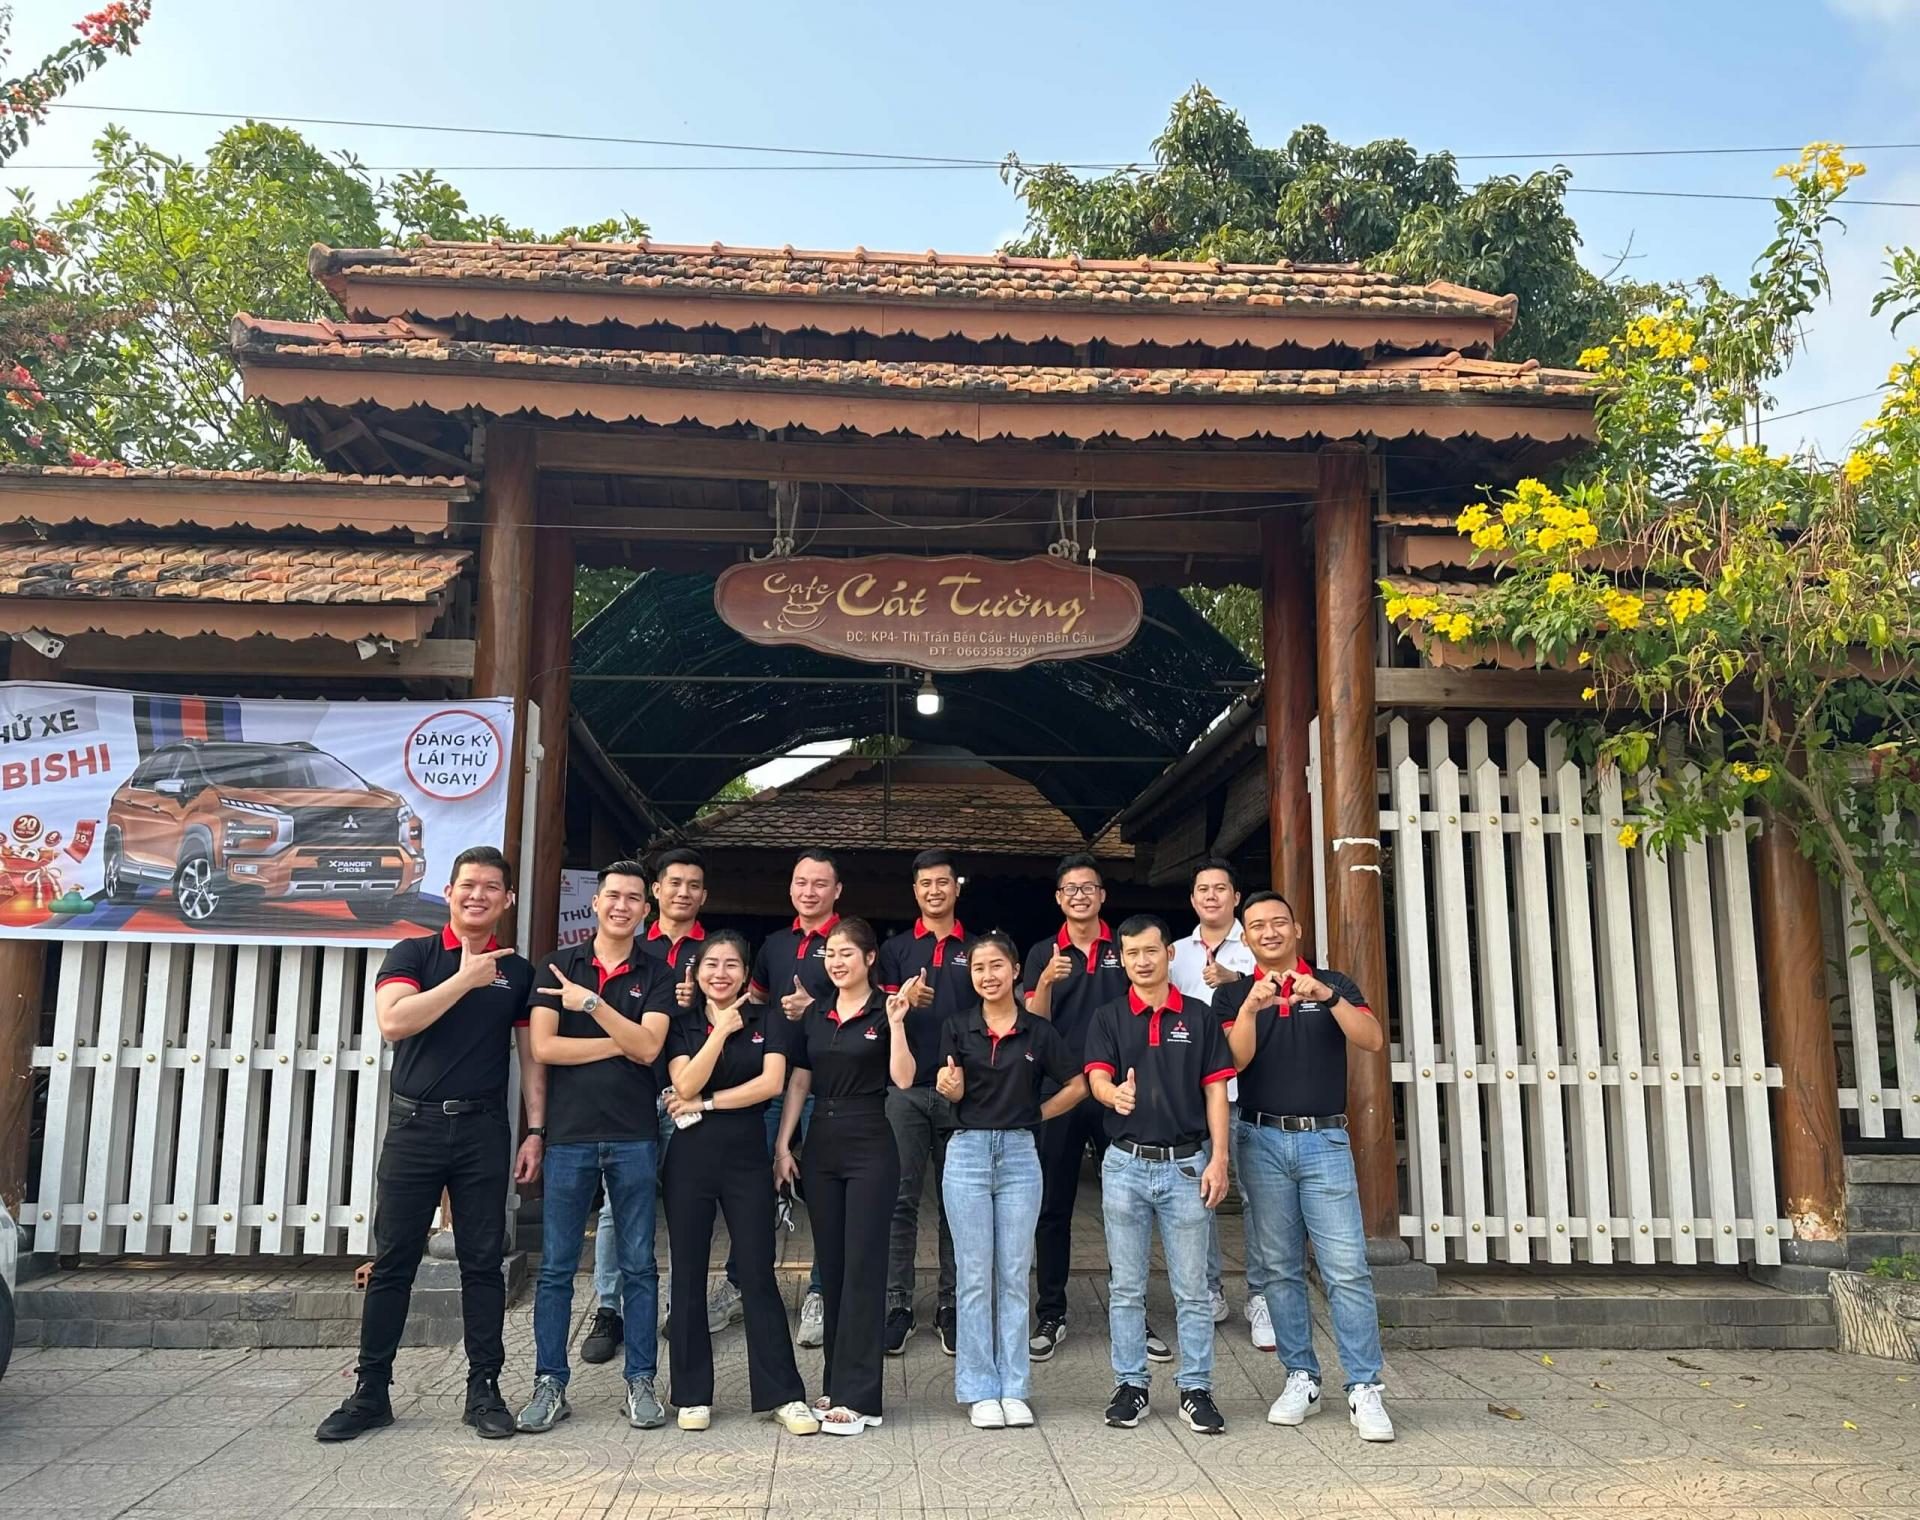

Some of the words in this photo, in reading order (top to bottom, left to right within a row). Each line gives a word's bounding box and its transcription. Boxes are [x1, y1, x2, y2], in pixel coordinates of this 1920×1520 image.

[837, 573, 928, 616] Cát
[938, 572, 1086, 634] Tường
[846, 631, 867, 642] ĐC:
[871, 631, 899, 642] KP4-
[929, 647, 952, 656] ĐT:
[40, 709, 79, 737] XE
[415, 731, 465, 746] ĐĂNG
[471, 732, 493, 747] KÝ
[418, 749, 444, 765] LÁI
[451, 750, 487, 767] THỬ
[2, 743, 111, 791] BISHI
[424, 771, 477, 786] NGAY!
[17, 816, 38, 831] 20
[561, 905, 592, 922] THỬ
